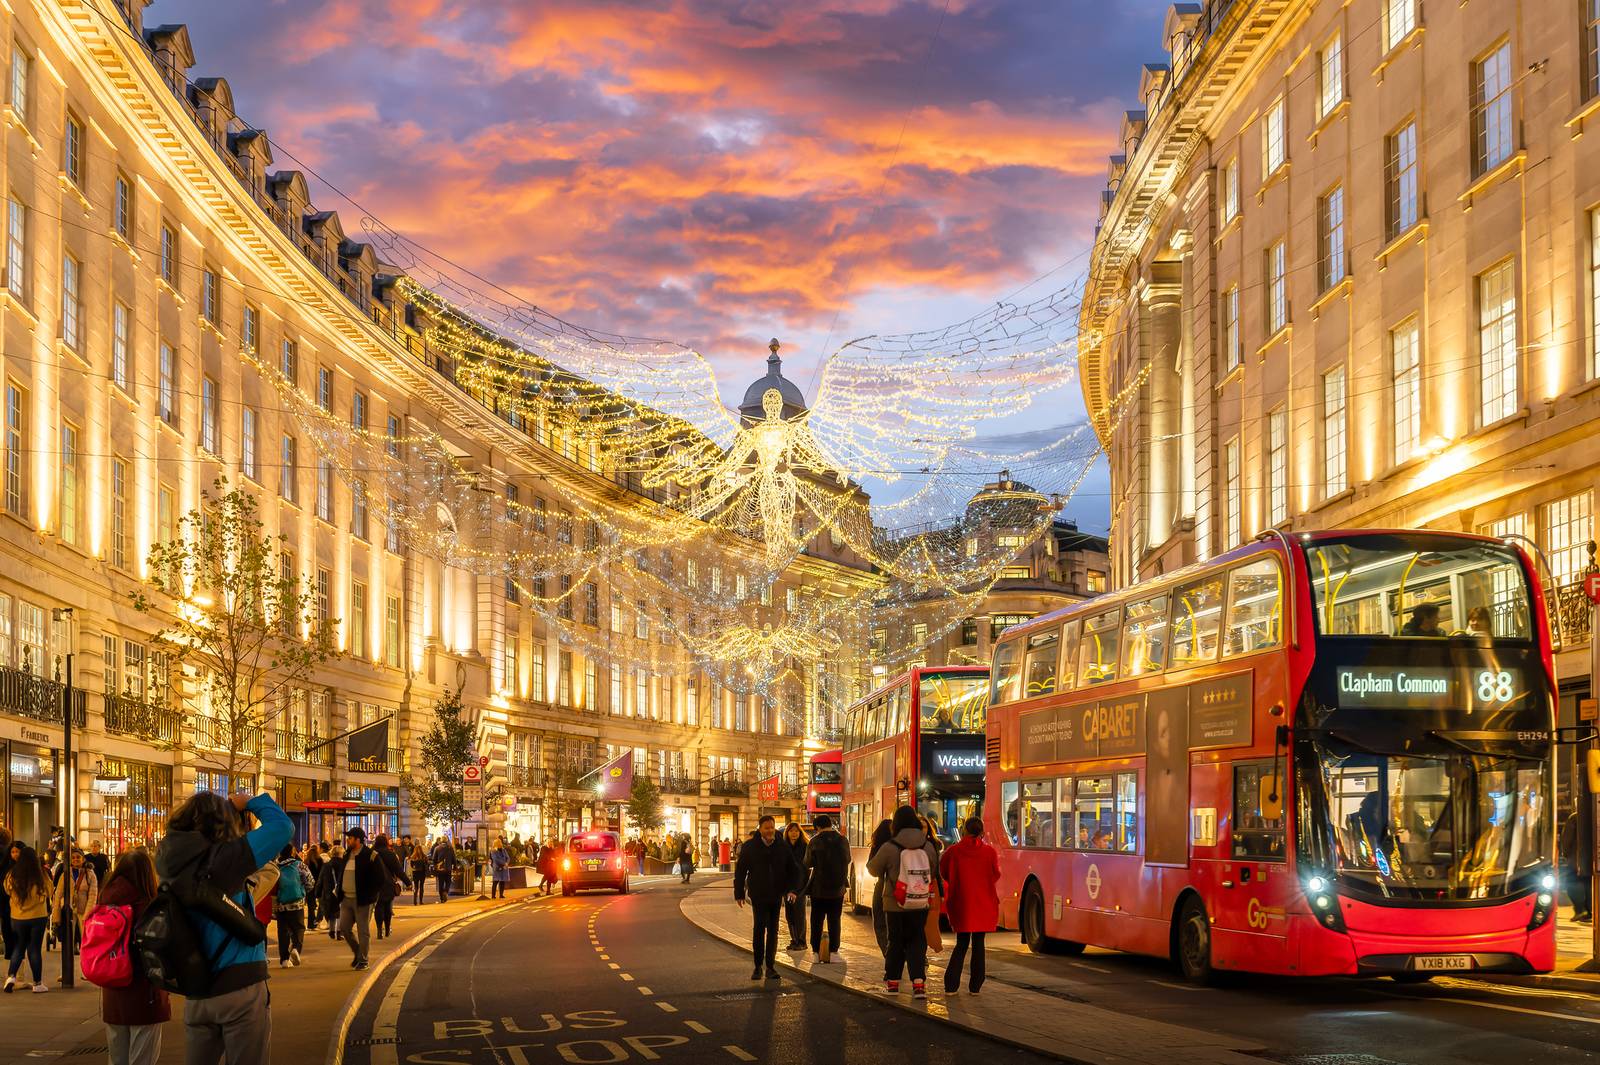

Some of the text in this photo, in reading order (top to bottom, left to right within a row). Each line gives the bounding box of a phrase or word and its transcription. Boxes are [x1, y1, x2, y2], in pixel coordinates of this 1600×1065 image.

[1341, 672, 1447, 698] Clapham Common
[1477, 671, 1513, 702] 88
[1082, 702, 1139, 741] CABARET
[1517, 730, 1548, 741] EH294
[26, 730, 49, 743] FABLETICS
[349, 762, 387, 771] HOLLISTER
[1248, 897, 1267, 929] Go
[1421, 958, 1465, 968] YX18 KXG
[433, 1010, 628, 1040] BUS
[406, 1035, 690, 1065] STOP
